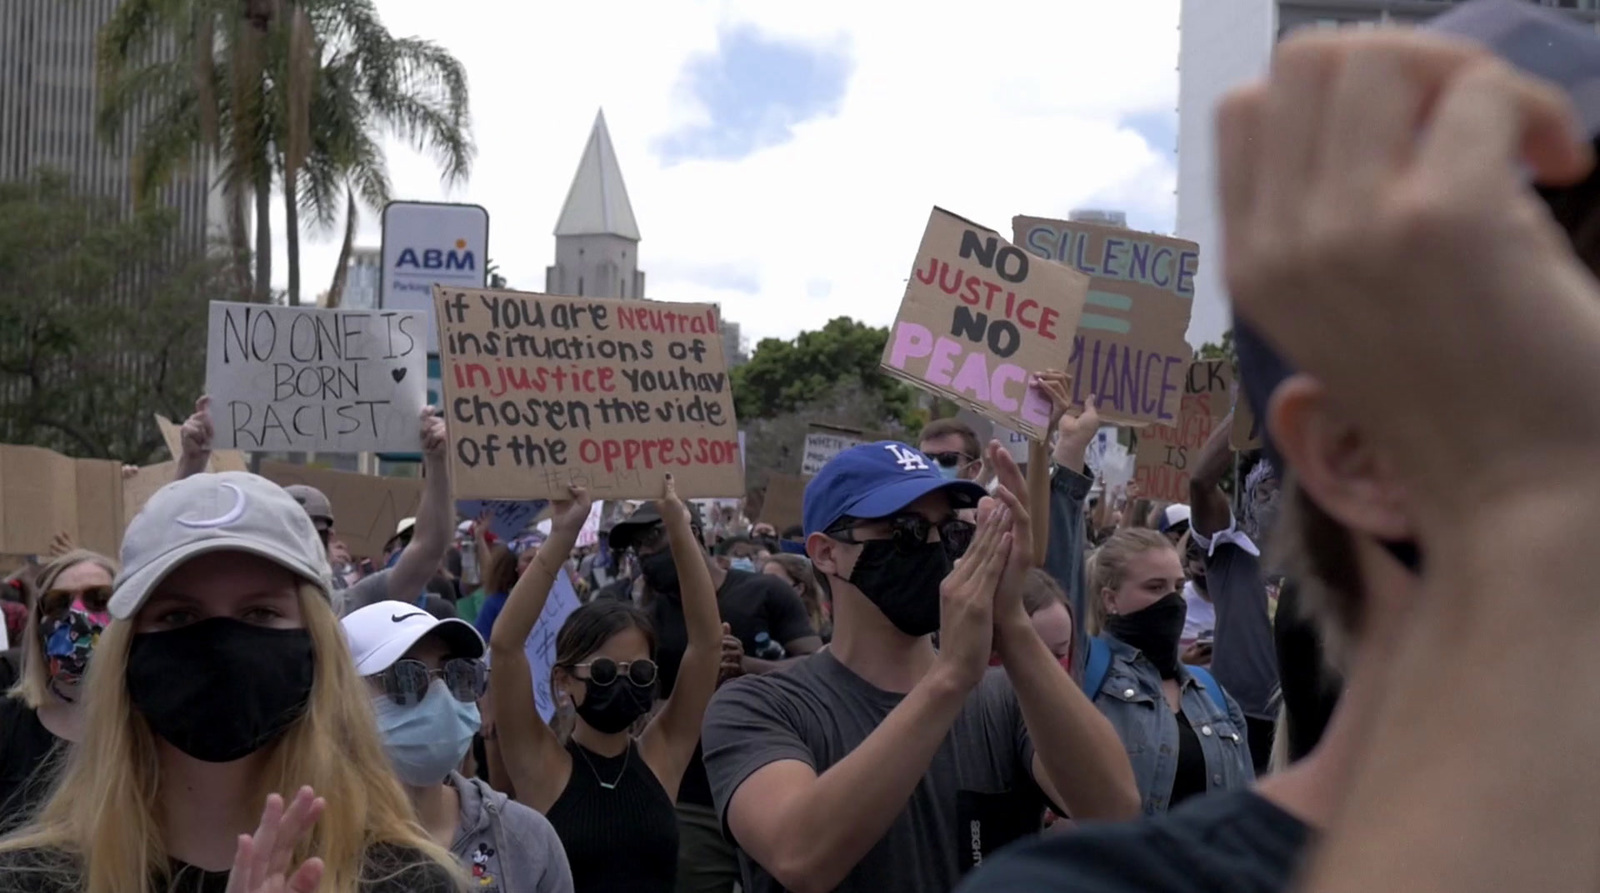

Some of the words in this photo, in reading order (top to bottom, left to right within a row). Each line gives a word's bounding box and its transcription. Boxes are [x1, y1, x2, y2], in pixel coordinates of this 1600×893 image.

[394, 247, 475, 271] ABM
[959, 229, 1029, 283] NO
[1028, 227, 1198, 293] SILENCE
[551, 302, 609, 330] are
[916, 258, 1060, 340] JUSTICE
[224, 308, 277, 363] NO
[290, 312, 371, 363] ONE
[380, 312, 414, 359] IS
[668, 338, 706, 363] of
[951, 305, 1021, 358] NO
[273, 363, 360, 401] BORN
[451, 357, 616, 396] injustice
[1068, 334, 1183, 420] LIANCE
[228, 400, 390, 449] RACIST
[454, 394, 591, 432] chosen
[593, 397, 650, 424] the
[655, 394, 726, 427] side
[507, 434, 567, 468] the
[579, 438, 738, 474] oppressor
[884, 444, 930, 471] LA
[1163, 445, 1188, 469] IS
